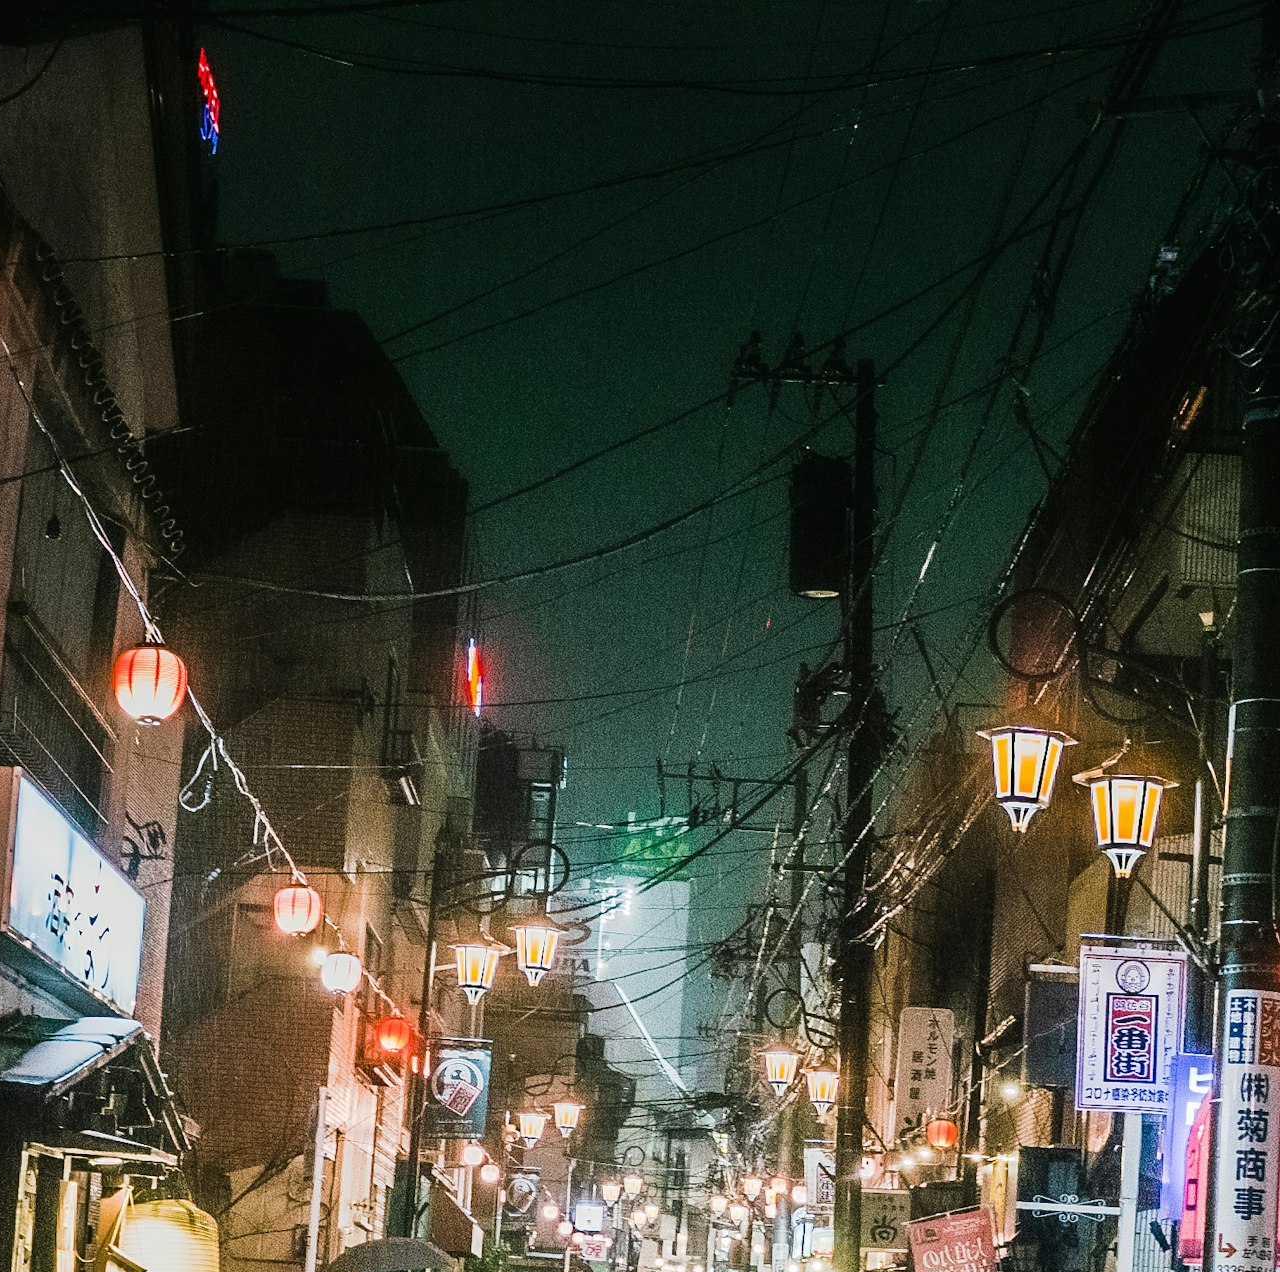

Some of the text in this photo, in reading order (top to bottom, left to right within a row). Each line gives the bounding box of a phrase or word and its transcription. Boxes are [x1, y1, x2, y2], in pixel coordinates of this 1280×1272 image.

[1113, 1014, 1150, 1077] 一番街
[1186, 1067, 1213, 1126] ヒ
